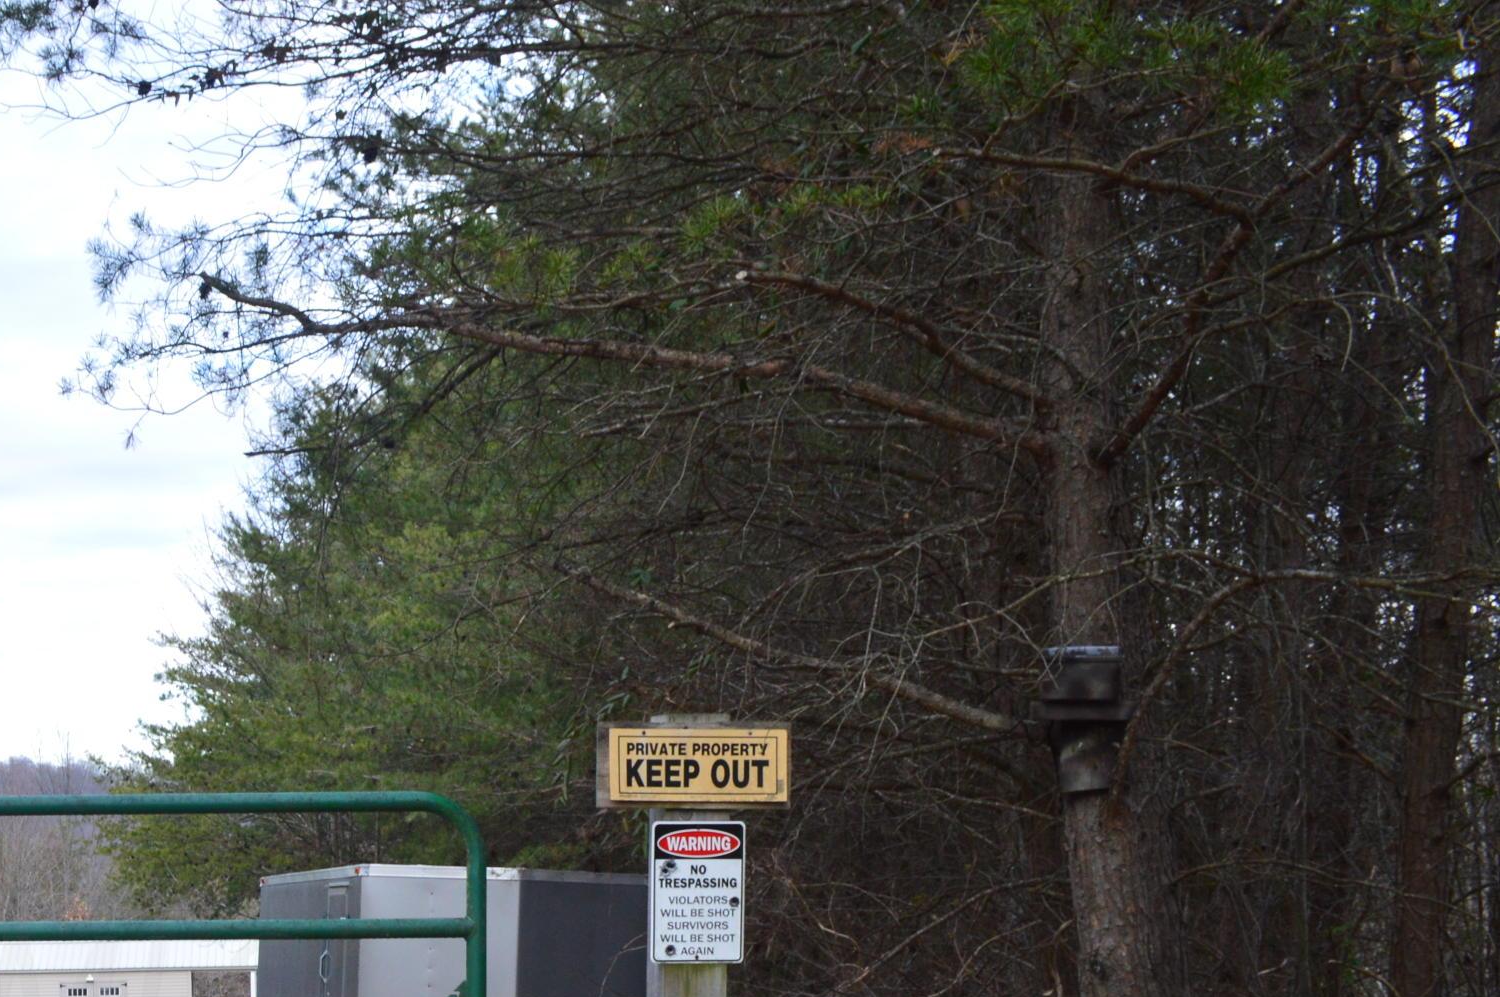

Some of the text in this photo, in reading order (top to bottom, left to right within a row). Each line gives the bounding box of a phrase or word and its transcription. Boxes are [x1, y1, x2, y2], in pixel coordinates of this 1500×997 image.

[627, 743, 768, 756] PRIVATE PROPERTY
[626, 758, 770, 788] KEEP OUT
[666, 836, 732, 851] WARNING
[690, 864, 707, 875] NO
[659, 878, 738, 889] TRESPASSING
[668, 896, 728, 905] VIOLATORS
[660, 908, 737, 918] WILL BE SHOT
[667, 921, 729, 930] SURVIVORS
[660, 934, 735, 943] WILL BE SHOT
[680, 947, 715, 956] AGAIN
